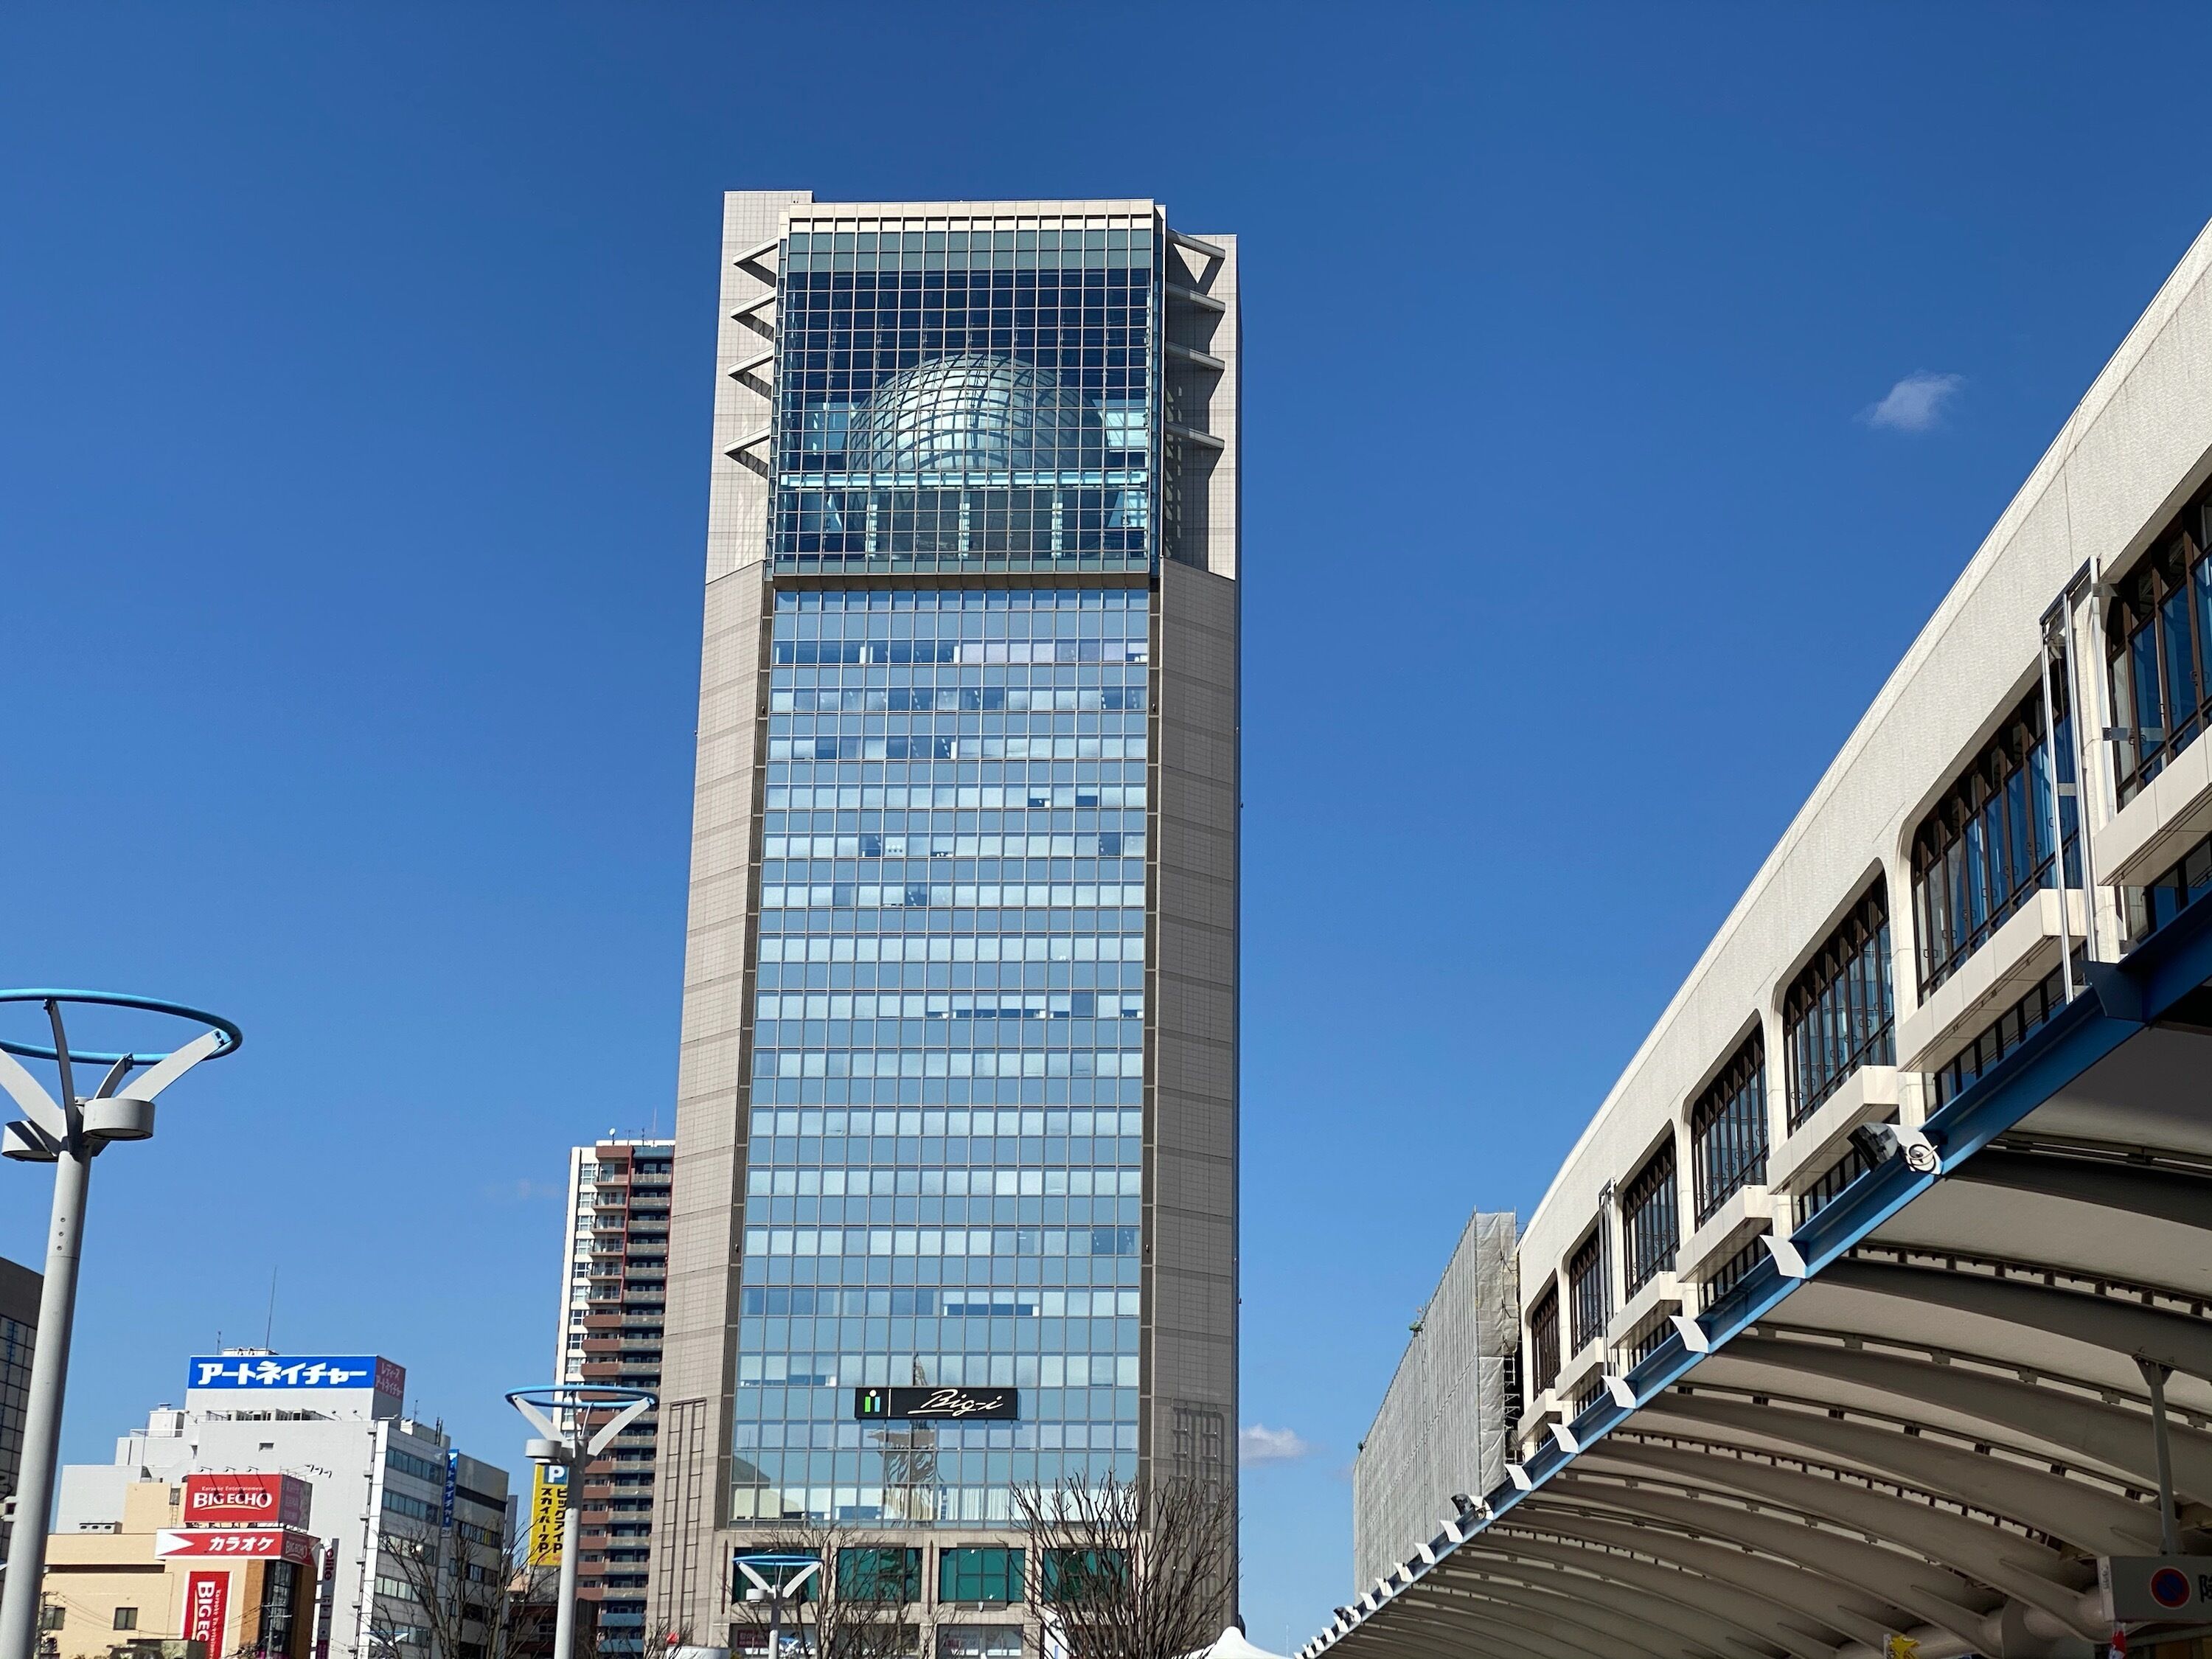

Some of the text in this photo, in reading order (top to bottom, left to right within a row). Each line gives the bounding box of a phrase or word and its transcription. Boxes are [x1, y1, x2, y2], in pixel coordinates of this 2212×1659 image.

[198, 1360, 367, 1385] アートネイチャー
[908, 1388, 1004, 1416] Big-i
[548, 1465, 565, 1484] P
[193, 1492, 273, 1509] BIG ECHO
[209, 1536, 275, 1552] カラオケ
[195, 1581, 216, 1641] BIG EC
